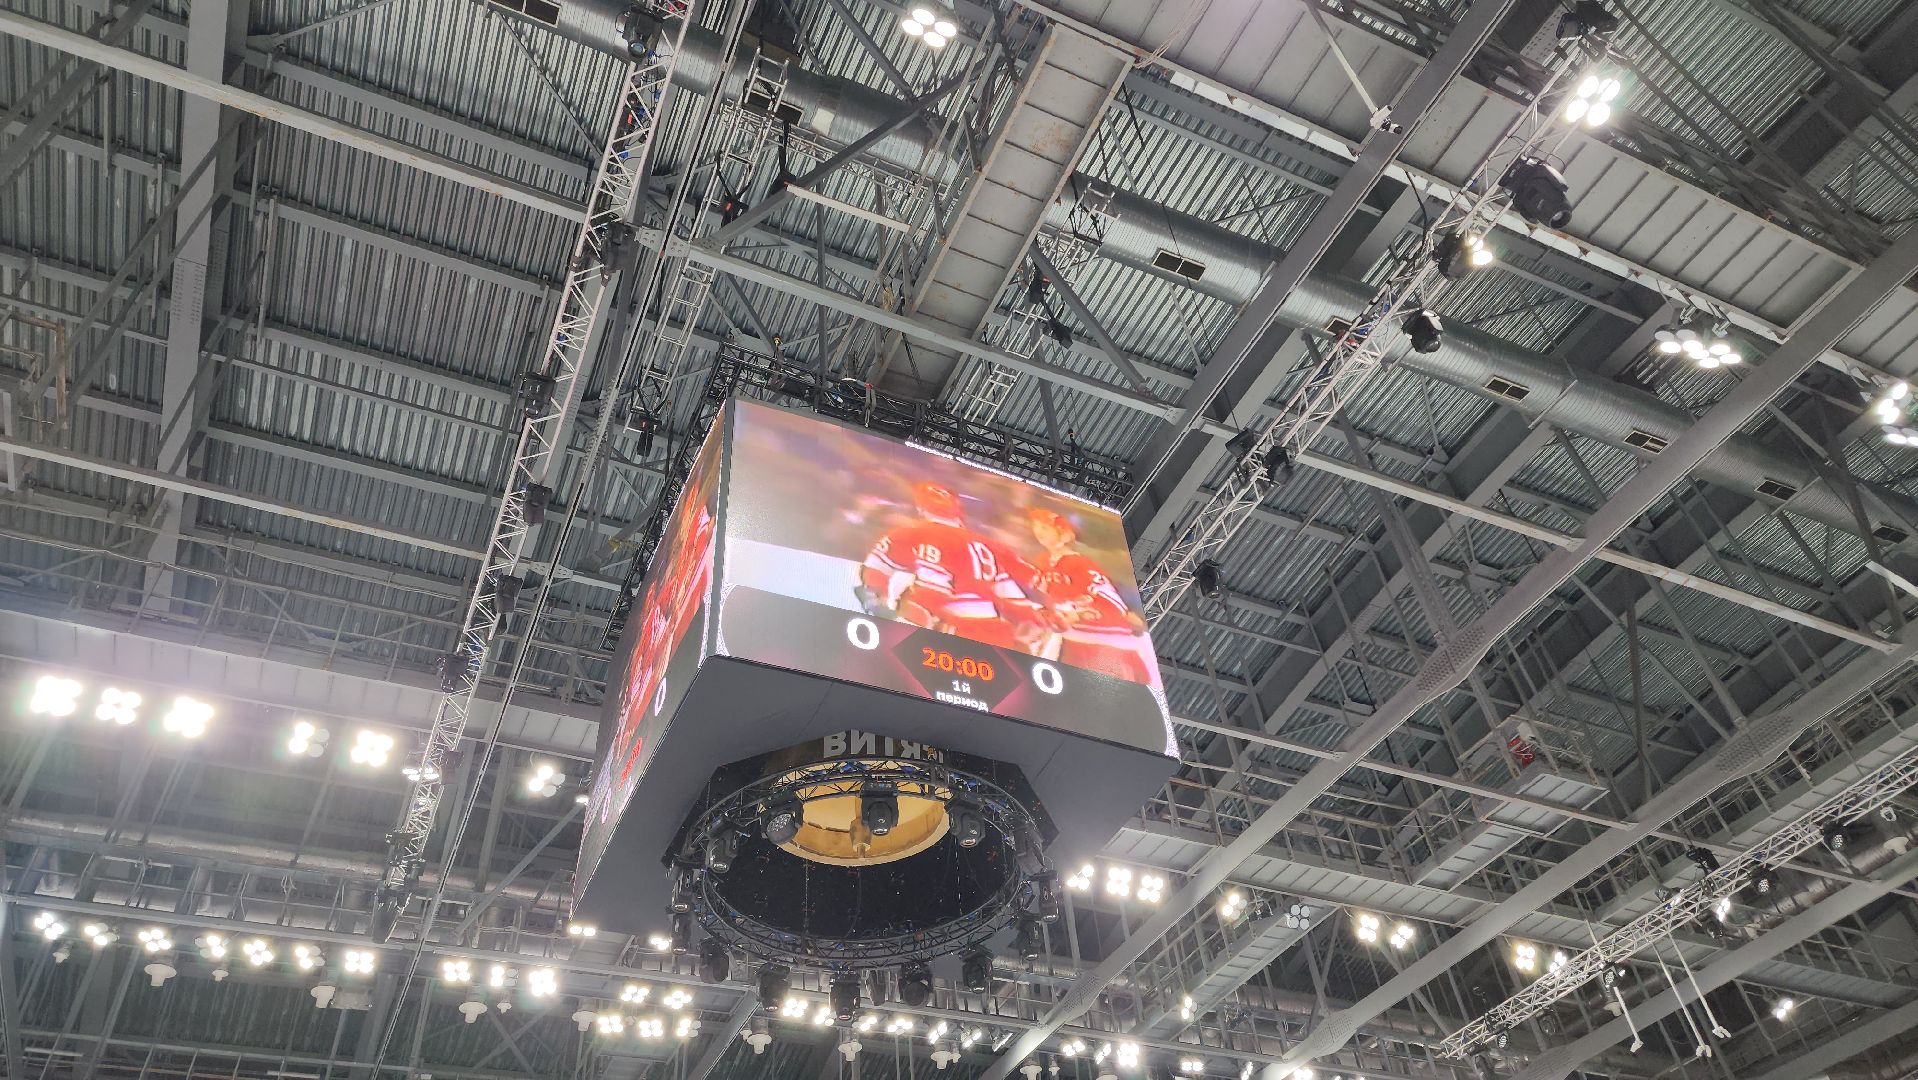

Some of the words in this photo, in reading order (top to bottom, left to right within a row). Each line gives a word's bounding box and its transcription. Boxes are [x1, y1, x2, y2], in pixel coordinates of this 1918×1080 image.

[967, 540, 997, 581] 19
[847, 617, 880, 650] 0
[922, 647, 994, 681] 20:00
[1032, 662, 1063, 694] 0
[936, 691, 989, 712] период
[952, 680, 971, 694] 1й
